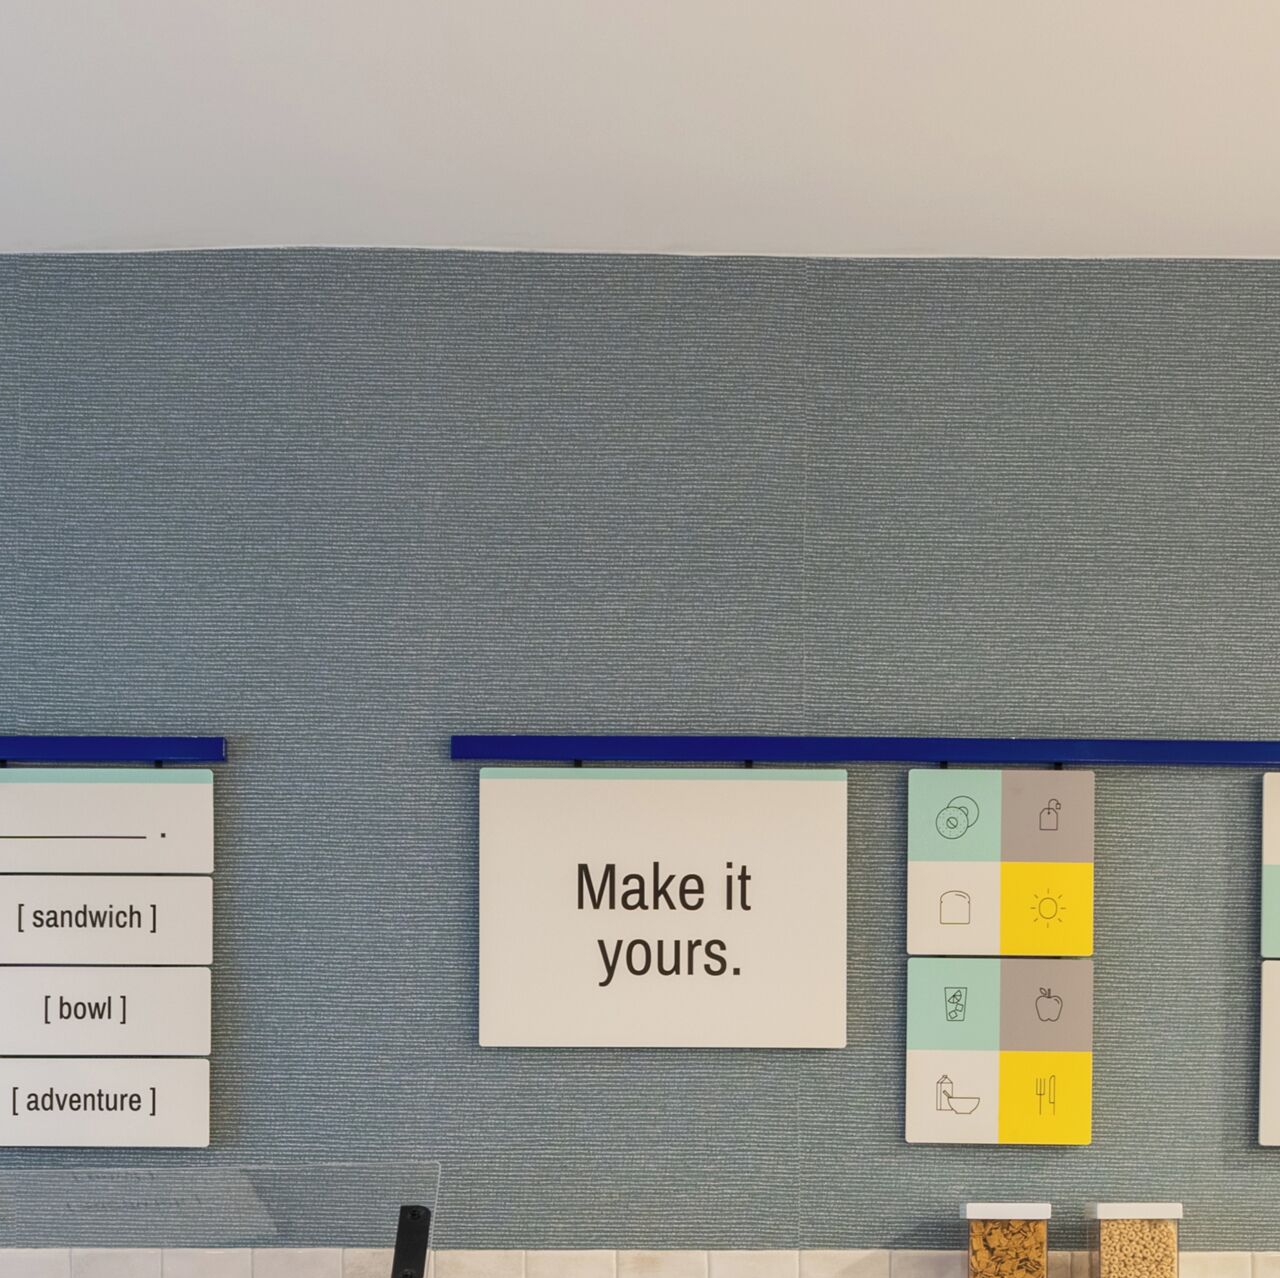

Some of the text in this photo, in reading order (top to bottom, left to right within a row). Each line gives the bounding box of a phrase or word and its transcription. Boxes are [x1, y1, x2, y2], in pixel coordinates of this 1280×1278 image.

[577, 861, 752, 912] Make it
[32, 903, 142, 929] sandwich
[597, 938, 741, 988] yours.
[59, 995, 112, 1020] bowl
[26, 1087, 142, 1112] adventure
